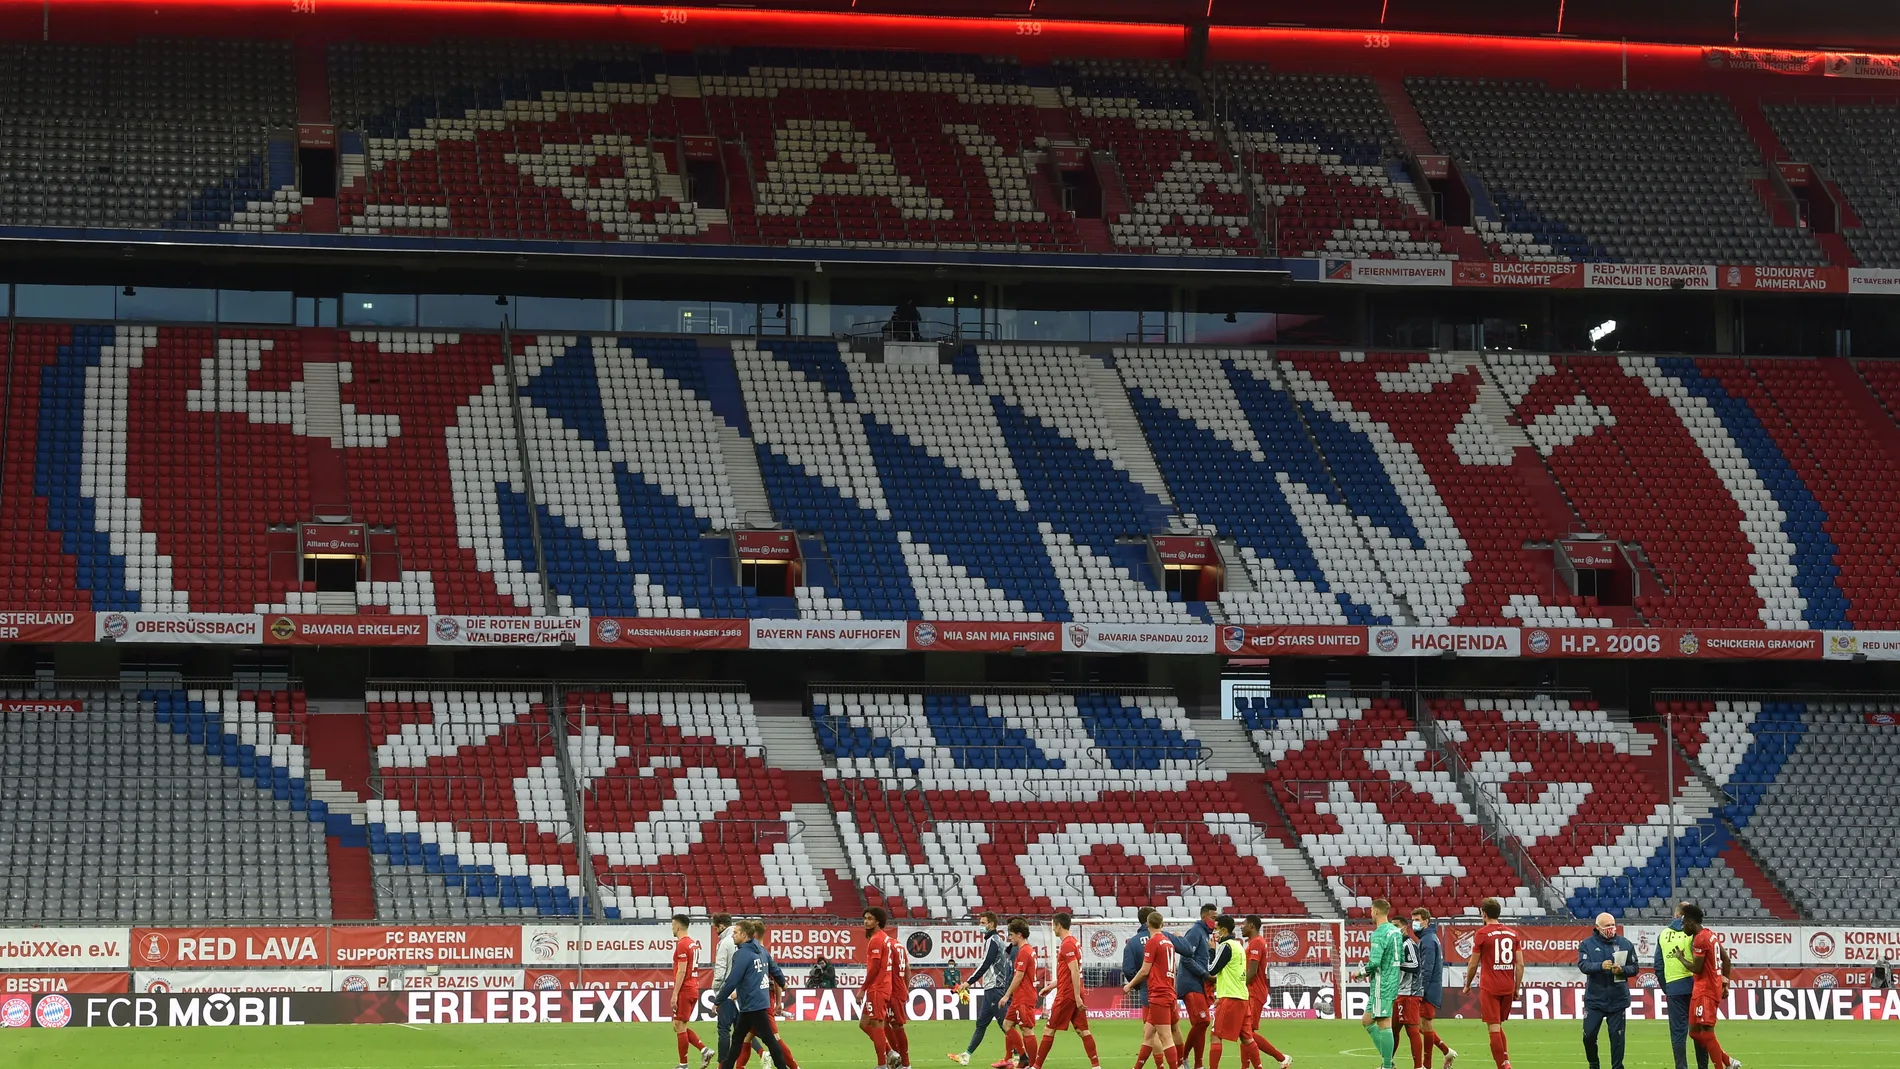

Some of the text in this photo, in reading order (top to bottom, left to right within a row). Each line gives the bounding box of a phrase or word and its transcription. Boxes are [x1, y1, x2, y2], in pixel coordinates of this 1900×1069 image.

[660, 9, 687, 24] 340
[1016, 22, 1042, 36] 339
[1364, 35, 1390, 49] 338
[1729, 61, 1810, 72] WARTBURGKREIS
[1855, 57, 1870, 65] DIE
[1873, 58, 1900, 67] ROTE
[1358, 267, 1446, 277] FEIERNMITBAYERN
[1492, 263, 1578, 275] BLACK-FOREST
[1593, 264, 1707, 275] RED-WHITE BAVARIA
[1493, 274, 1551, 285] DYNAMITE
[1591, 276, 1709, 287] FANCLUB NORDORN
[1754, 279, 1827, 290] AMMERLAND
[306, 540, 334, 548] Allianz
[1160, 551, 1177, 559] llianz
[1594, 556, 1612, 564] Arena
[135, 618, 256, 635] OBERSÜSSBACH
[302, 624, 354, 635] BAVARIA
[357, 624, 421, 635] ERKELENZ
[466, 618, 581, 630] DIE ROTEN BULLEN
[466, 631, 576, 644] WALDBERG/RHÖN
[627, 626, 692, 637] MASSENHÄUSER
[693, 628, 719, 637] HASEN
[720, 629, 742, 637] 1988
[756, 629, 803, 640] BAYERN
[805, 629, 837, 640] FANS
[839, 629, 901, 640] AUFHOFEN
[943, 630, 963, 641] MIA
[966, 631, 987, 641] SAN
[990, 631, 1010, 641] MIA
[1013, 631, 1055, 641] FINSING
[1098, 633, 1209, 643] BAVARIA SPANDAU 2012
[1251, 636, 1360, 646] RED STARS UNITED
[1411, 634, 1508, 650] HACIENDA
[1561, 635, 1600, 652] H.P.
[1606, 634, 1661, 652] 2006
[1706, 638, 1815, 649] SCHICKERIA GRAMONT
[1862, 641, 1881, 650] RED
[385, 931, 466, 944] FC BAYERN
[771, 930, 851, 944] RED BOYS
[1730, 932, 1792, 945] WEISSEN
[0, 941, 120, 958] rbüXXen e.V.
[177, 937, 319, 961] RED LAVA
[567, 940, 703, 951] RED EAGLES AUSTA
[1494, 938, 1513, 964] 18
[337, 948, 514, 961] SUPPORTERS DILLINGEN
[771, 945, 856, 960] HASSFURT
[1844, 948, 1879, 960] BAZI
[6, 978, 68, 992] BESTIA
[437, 976, 479, 988] BAZIS
[483, 976, 515, 988] VUM
[1846, 973, 1866, 985] DIE
[408, 991, 562, 1024] ERLEBE
[1862, 989, 1900, 1021] FA
[86, 998, 158, 1028] FCB
[1105, 1010, 1131, 1018] SPORT
[1281, 1010, 1306, 1019] SPORT
